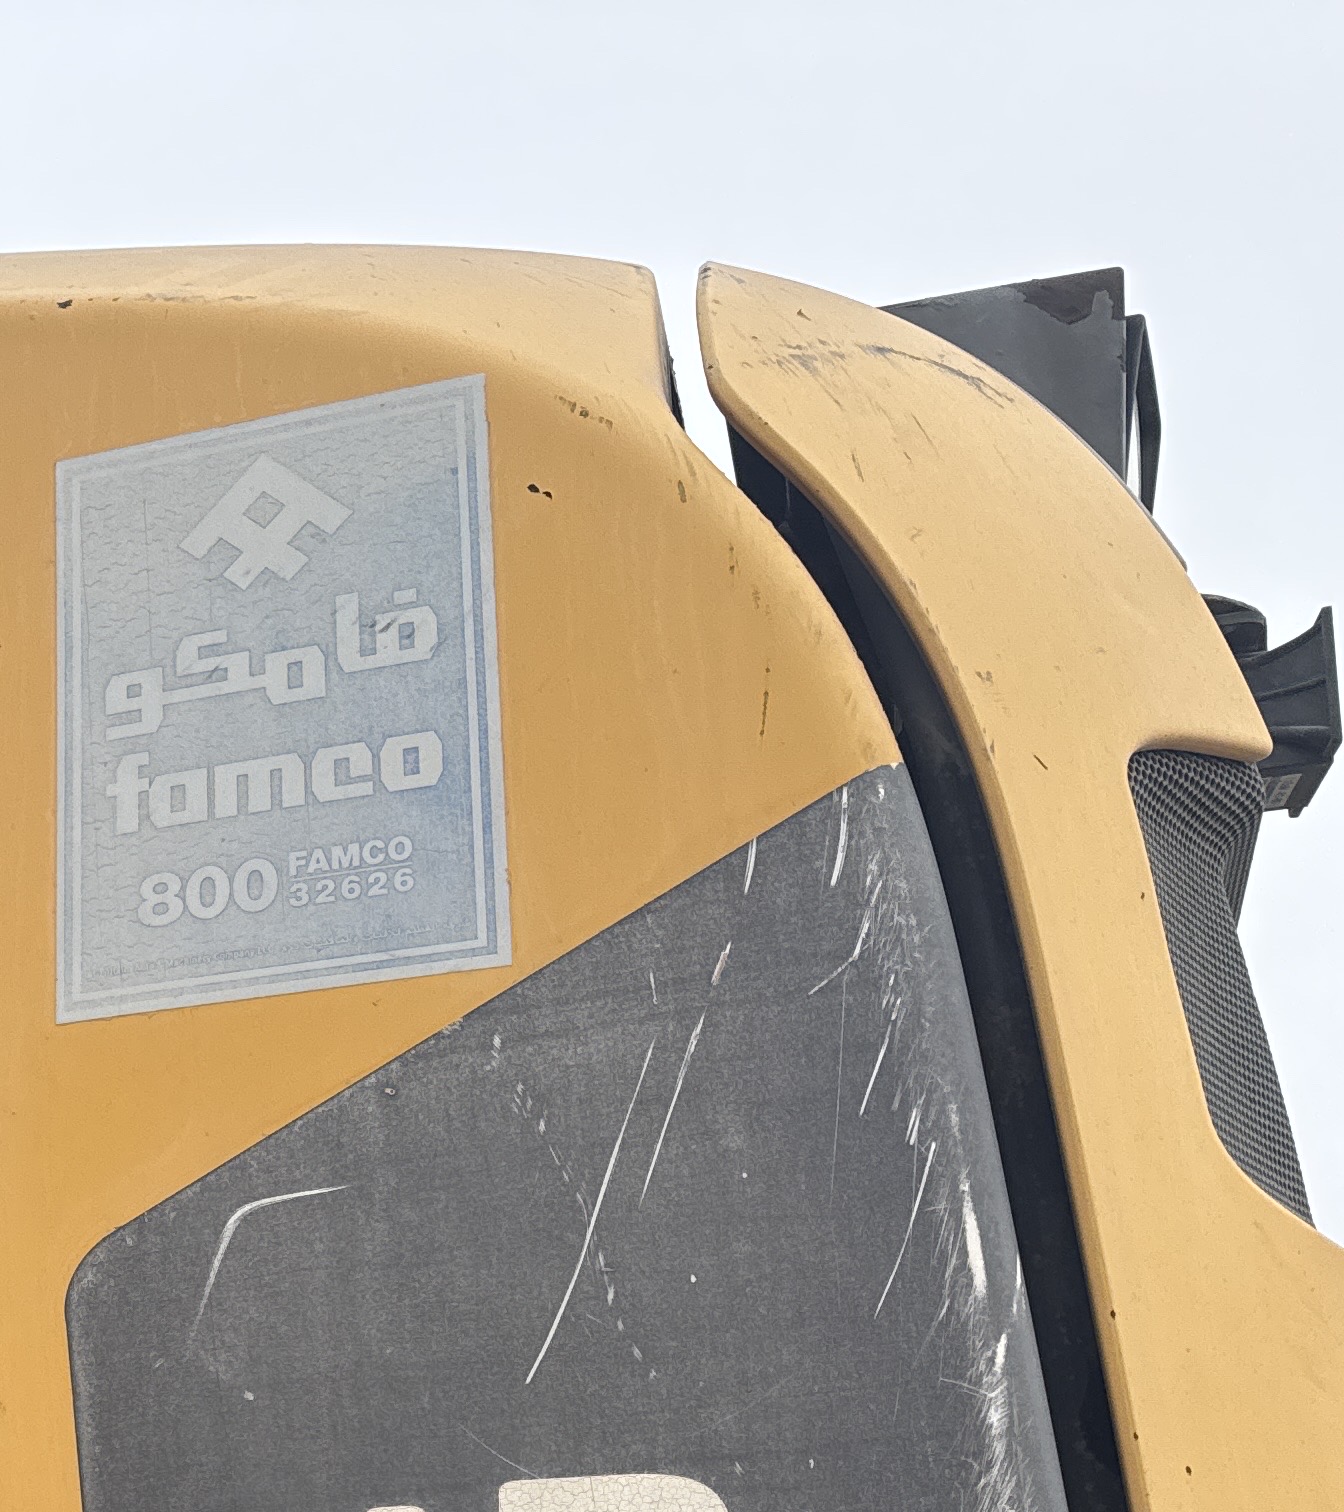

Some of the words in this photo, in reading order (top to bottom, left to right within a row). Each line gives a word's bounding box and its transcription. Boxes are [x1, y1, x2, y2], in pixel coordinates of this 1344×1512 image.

[105, 588, 439, 741] فامكو
[106, 730, 444, 835] famco
[136, 858, 279, 927] 800
[288, 835, 413, 877] FAMCO
[288, 867, 415, 908] 32626
